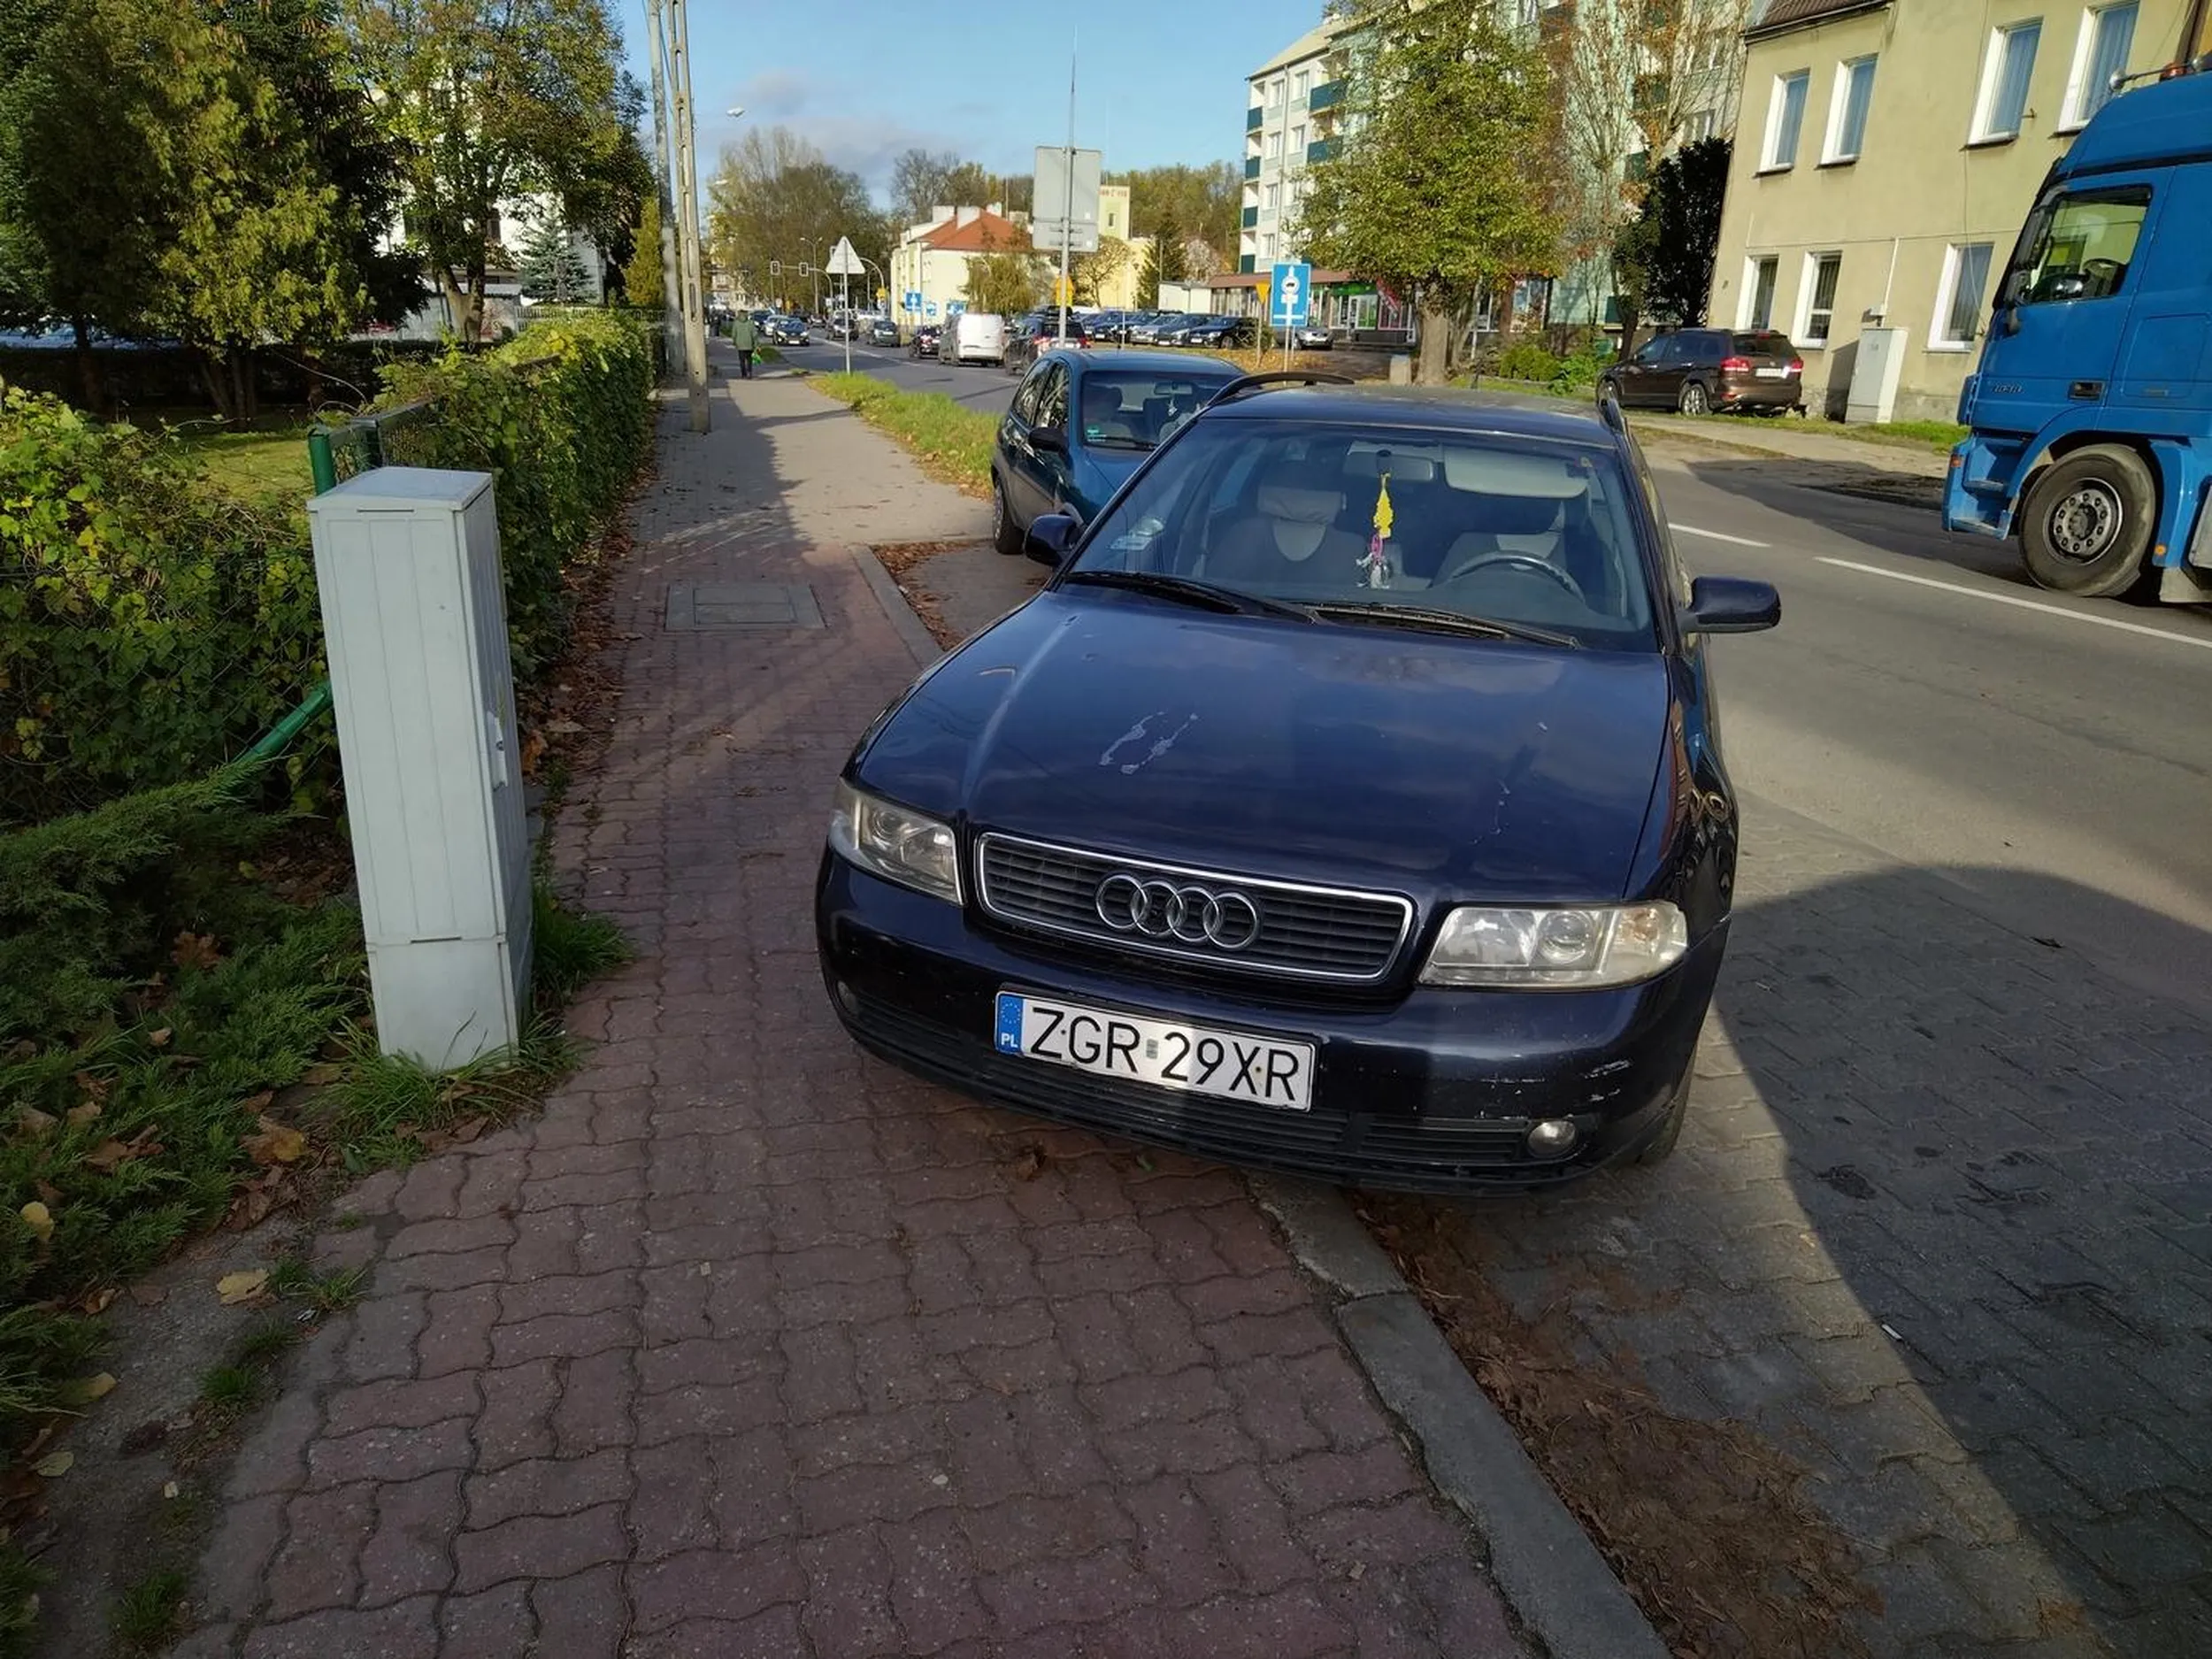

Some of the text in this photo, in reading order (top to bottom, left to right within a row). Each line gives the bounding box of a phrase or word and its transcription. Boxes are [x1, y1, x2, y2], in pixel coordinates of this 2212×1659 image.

[1001, 1032, 1018, 1048] PL
[1031, 1007, 1298, 1100] ZGR 29XR
